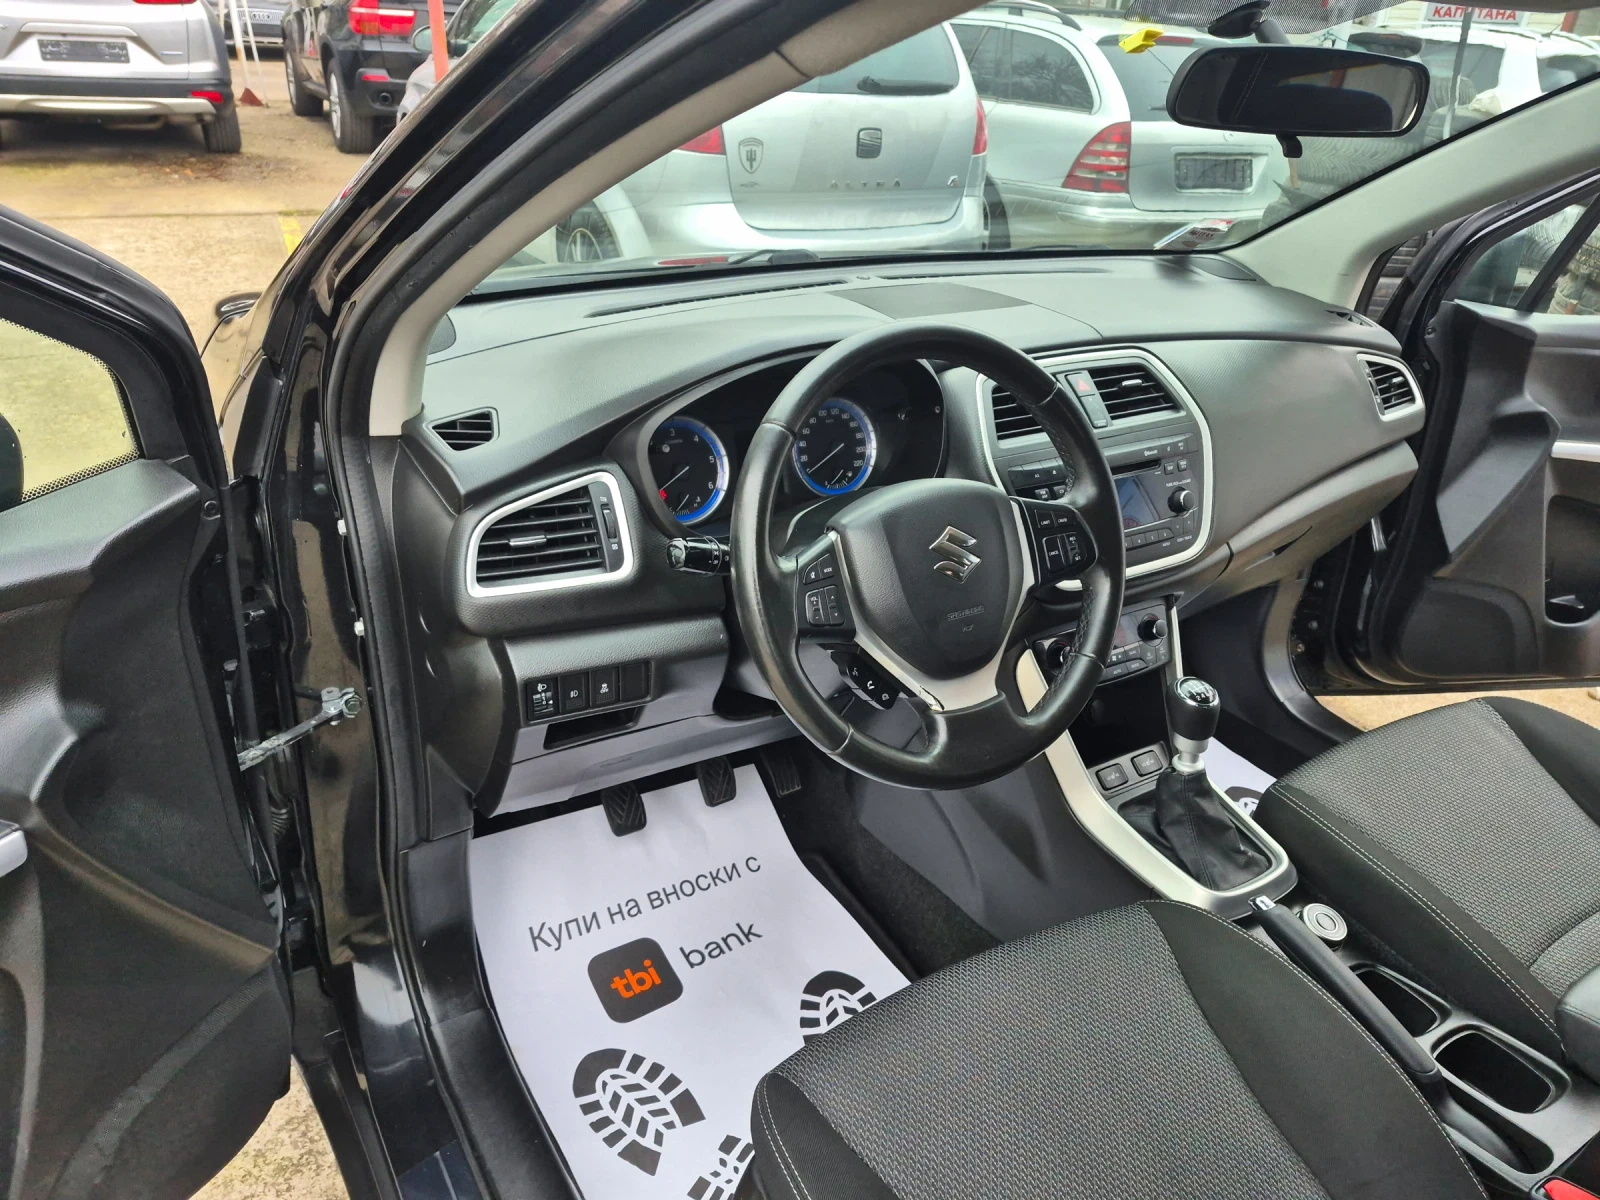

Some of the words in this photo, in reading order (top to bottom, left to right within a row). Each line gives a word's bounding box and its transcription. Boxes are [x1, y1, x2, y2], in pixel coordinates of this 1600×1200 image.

[1432, 6, 1516, 20] КАПТАНА
[669, 428, 676, 437] 3
[693, 434, 700, 443] 4
[708, 455, 715, 464] 5
[800, 454, 808, 462] 20
[708, 481, 714, 489] 6
[528, 911, 601, 952] Купи
[606, 897, 642, 925] на
[646, 862, 742, 910] вноски
[745, 856, 761, 873] с
[610, 959, 662, 999] tbi
[679, 922, 764, 969] bank
